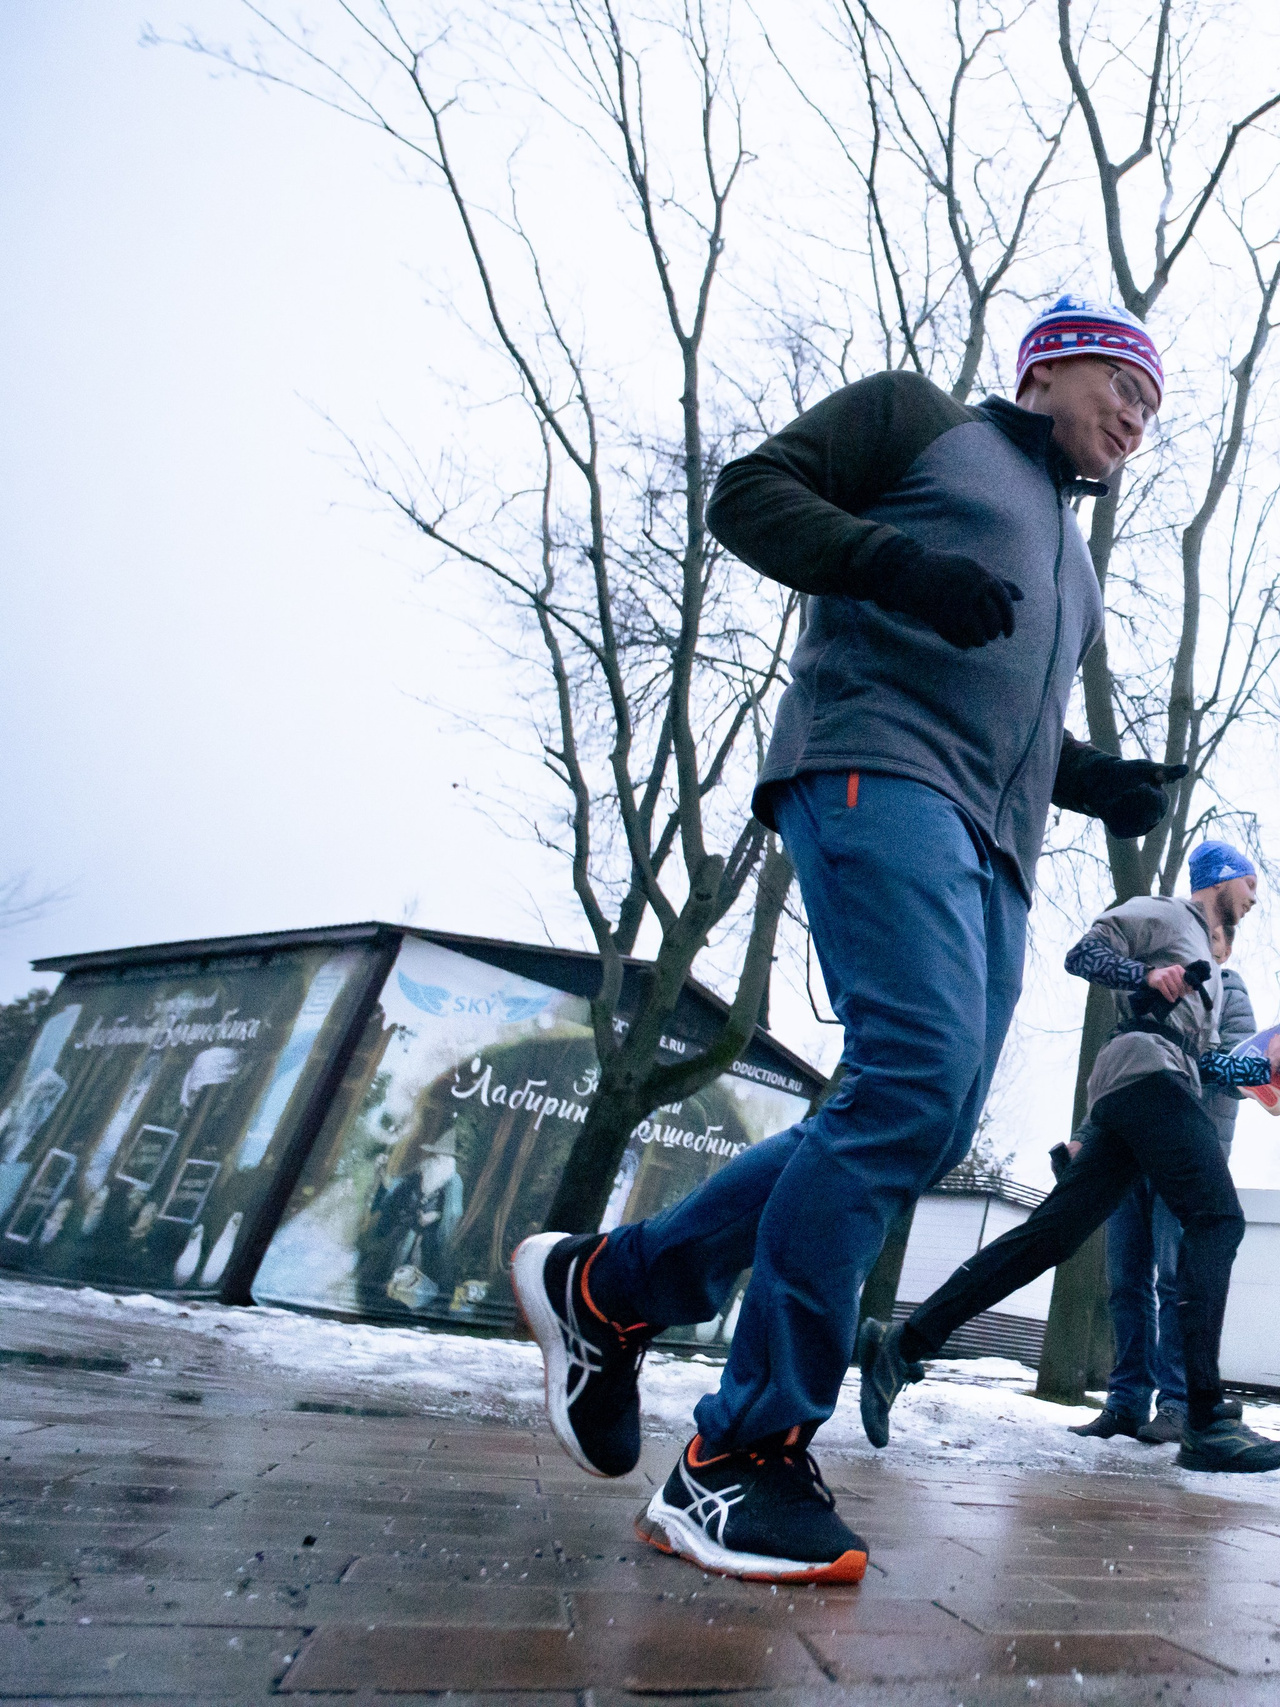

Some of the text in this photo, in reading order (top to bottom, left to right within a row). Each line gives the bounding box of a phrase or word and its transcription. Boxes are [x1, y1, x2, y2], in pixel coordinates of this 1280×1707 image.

[453, 995, 497, 1015] SKY
[730, 1060, 803, 1092] ODUCTION.RU
[451, 1057, 589, 1131] Лабирин
[630, 1120, 752, 1158] олшебник
